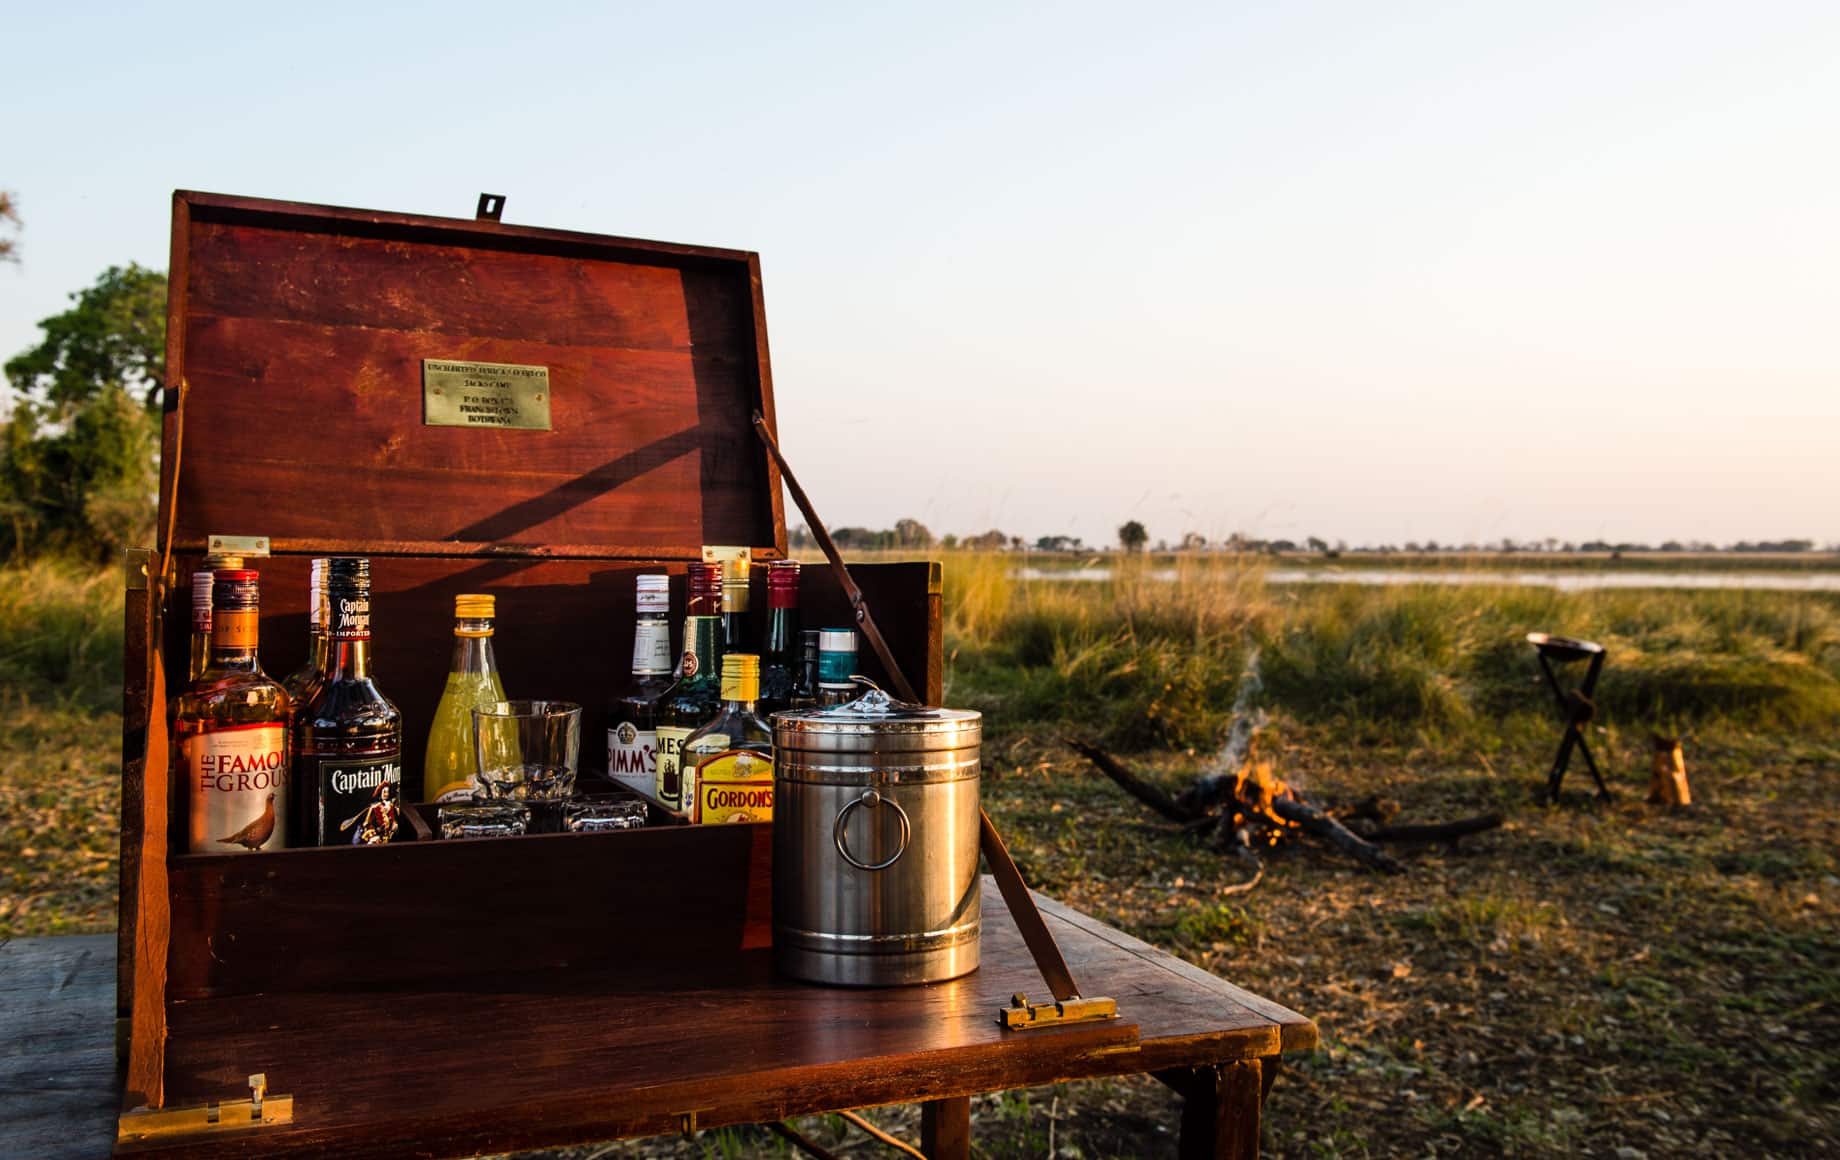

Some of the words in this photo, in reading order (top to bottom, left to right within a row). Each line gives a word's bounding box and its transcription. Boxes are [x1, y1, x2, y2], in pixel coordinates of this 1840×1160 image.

[468, 416, 511, 425] BOTSWANA
[339, 598, 369, 614] Captain
[200, 754, 215, 792] THE
[331, 766, 382, 794] Captain
[706, 787, 773, 810] GORDON'S
